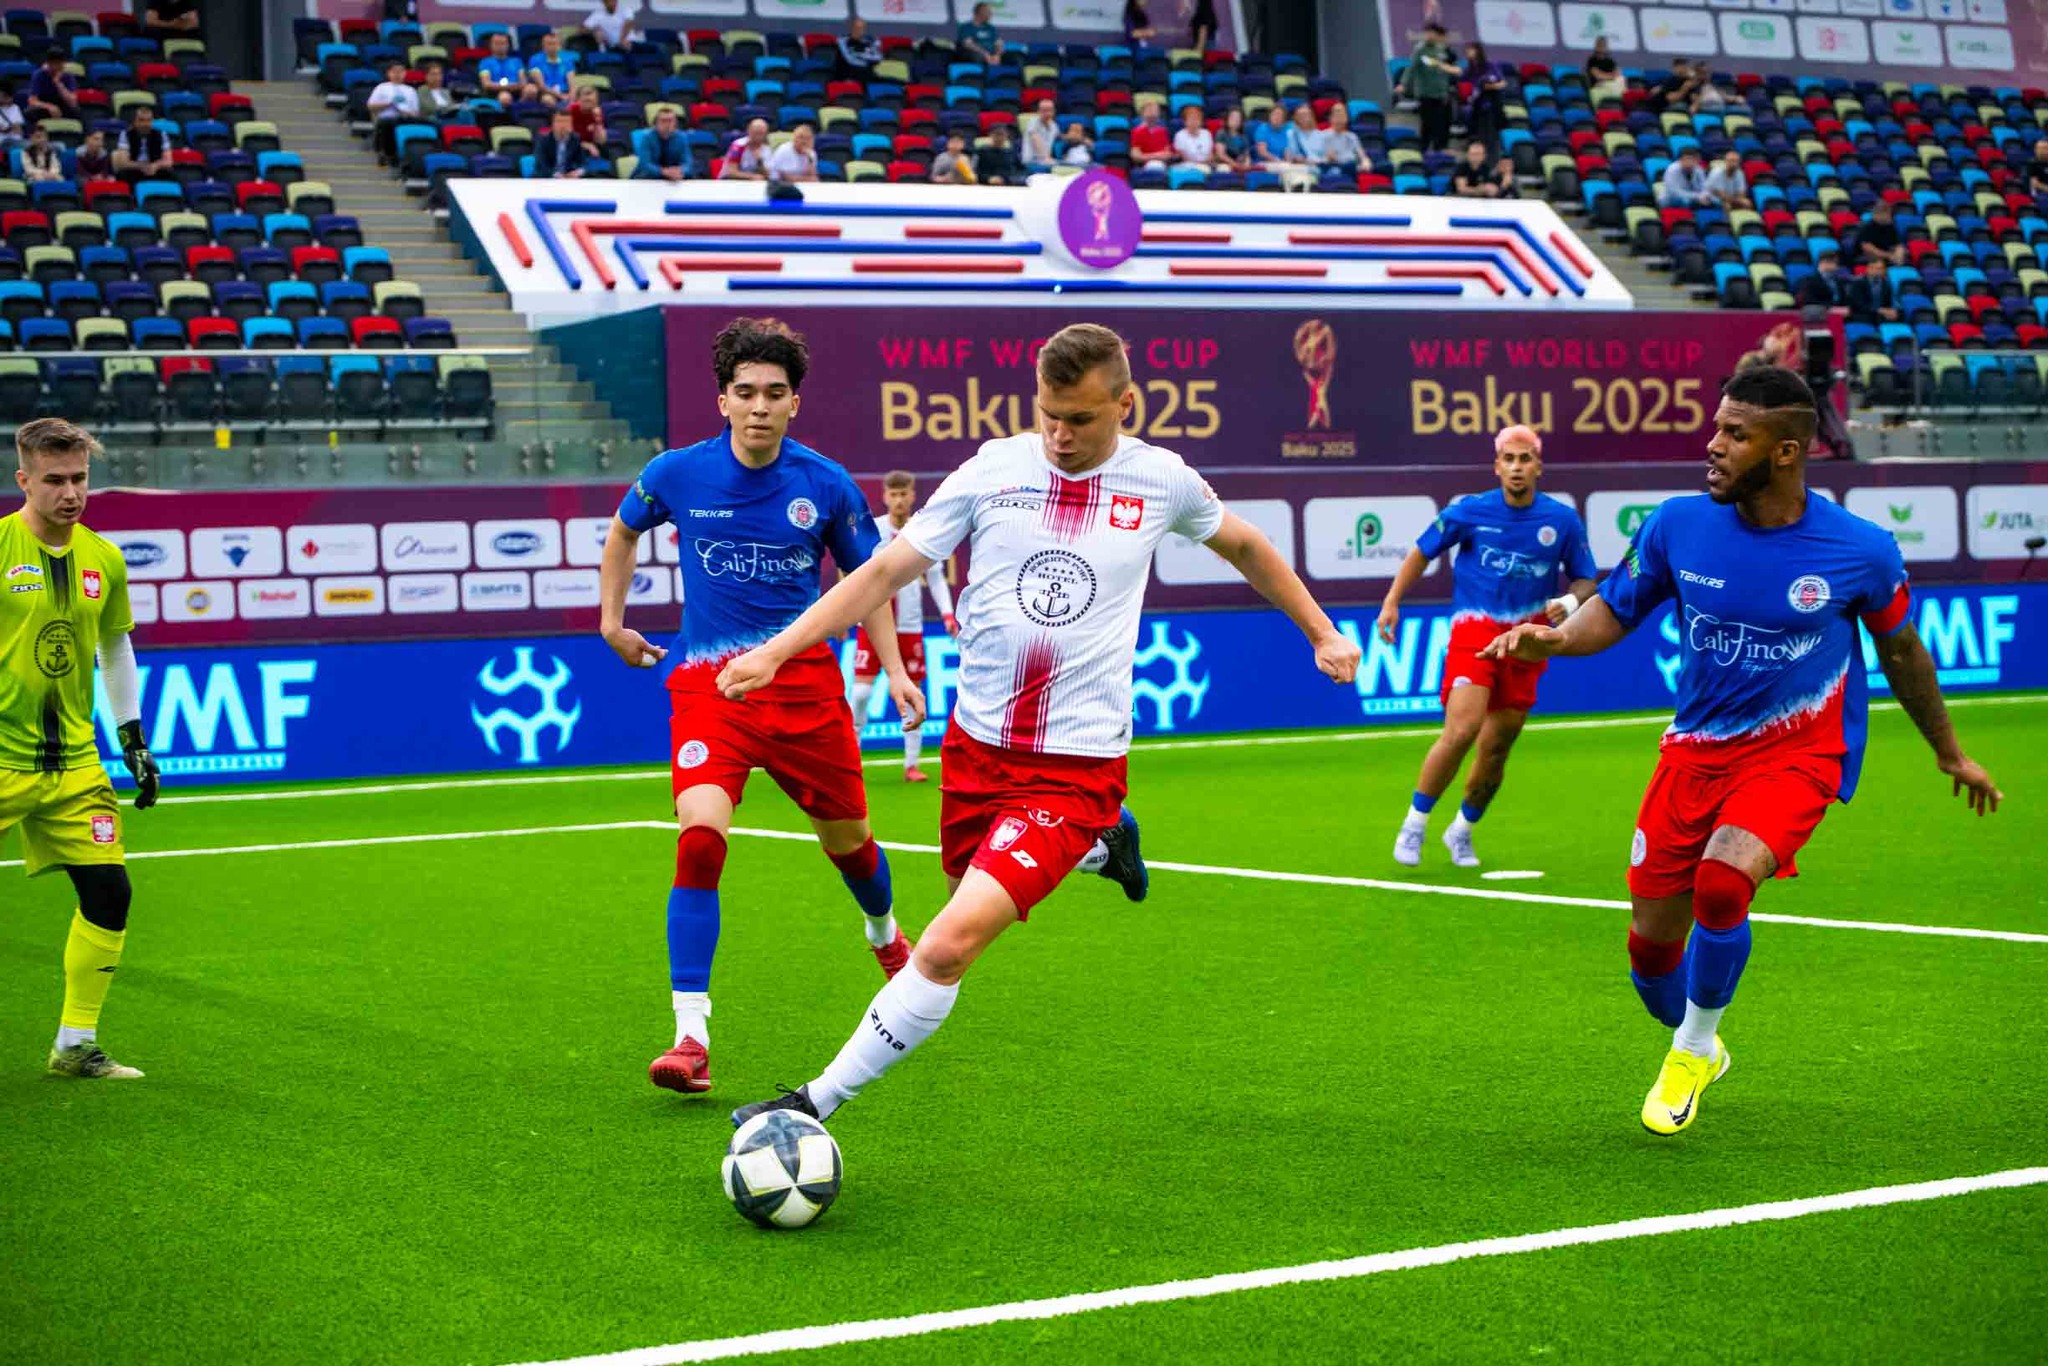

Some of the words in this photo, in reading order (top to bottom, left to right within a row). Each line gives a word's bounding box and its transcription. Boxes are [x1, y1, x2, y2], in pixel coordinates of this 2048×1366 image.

[879, 338, 974, 369] WMF
[1147, 338, 1218, 368] CUP
[1410, 340, 1491, 368] WMF
[1505, 340, 1627, 368] WORLD
[1640, 340, 1704, 368] CUP
[880, 376, 1043, 440] Baku
[1119, 379, 1221, 438] 025
[1411, 374, 1552, 434] Baku
[1573, 377, 1706, 433] 2025
[1857, 595, 2018, 668] MF
